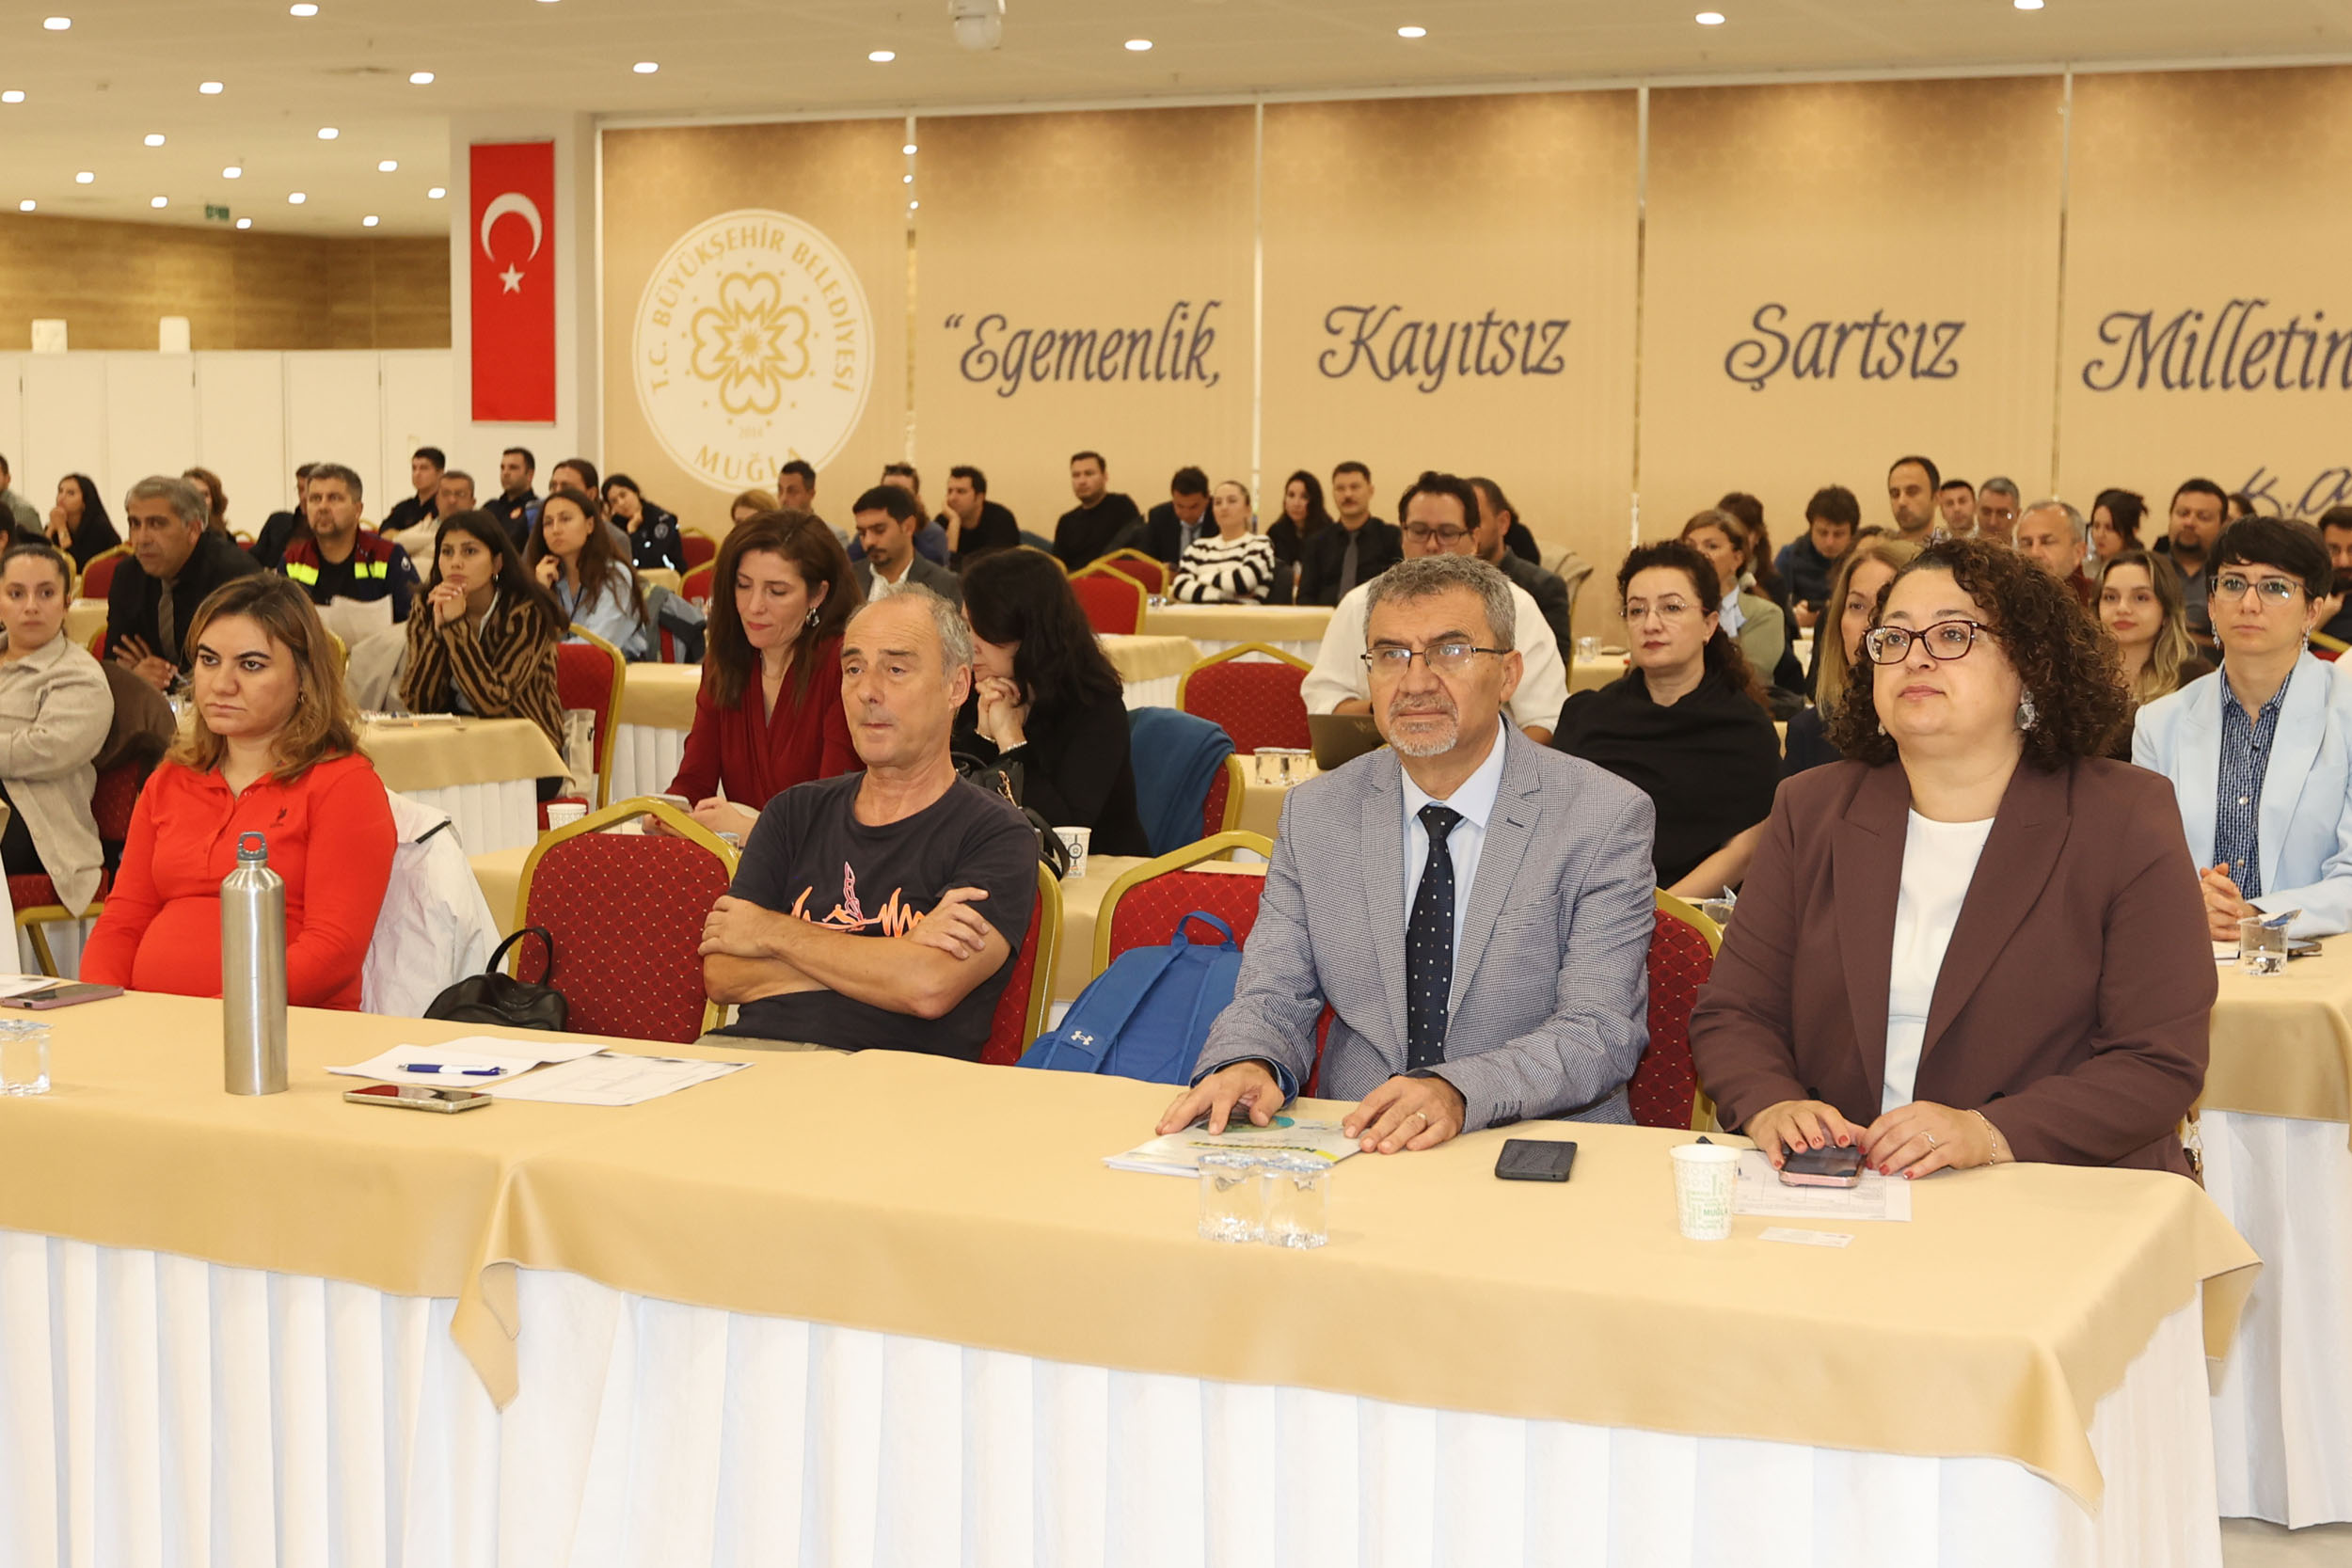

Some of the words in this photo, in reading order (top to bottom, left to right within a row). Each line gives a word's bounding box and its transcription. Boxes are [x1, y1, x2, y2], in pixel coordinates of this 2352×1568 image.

[652, 221, 786, 328] BÜYÜKŞEHİR
[790, 241, 857, 393] BELEDİYESİ
[648, 341, 670, 394] T.C.
[1317, 304, 1571, 393] Kayıtsız
[1724, 302, 1967, 392] Şartsız
